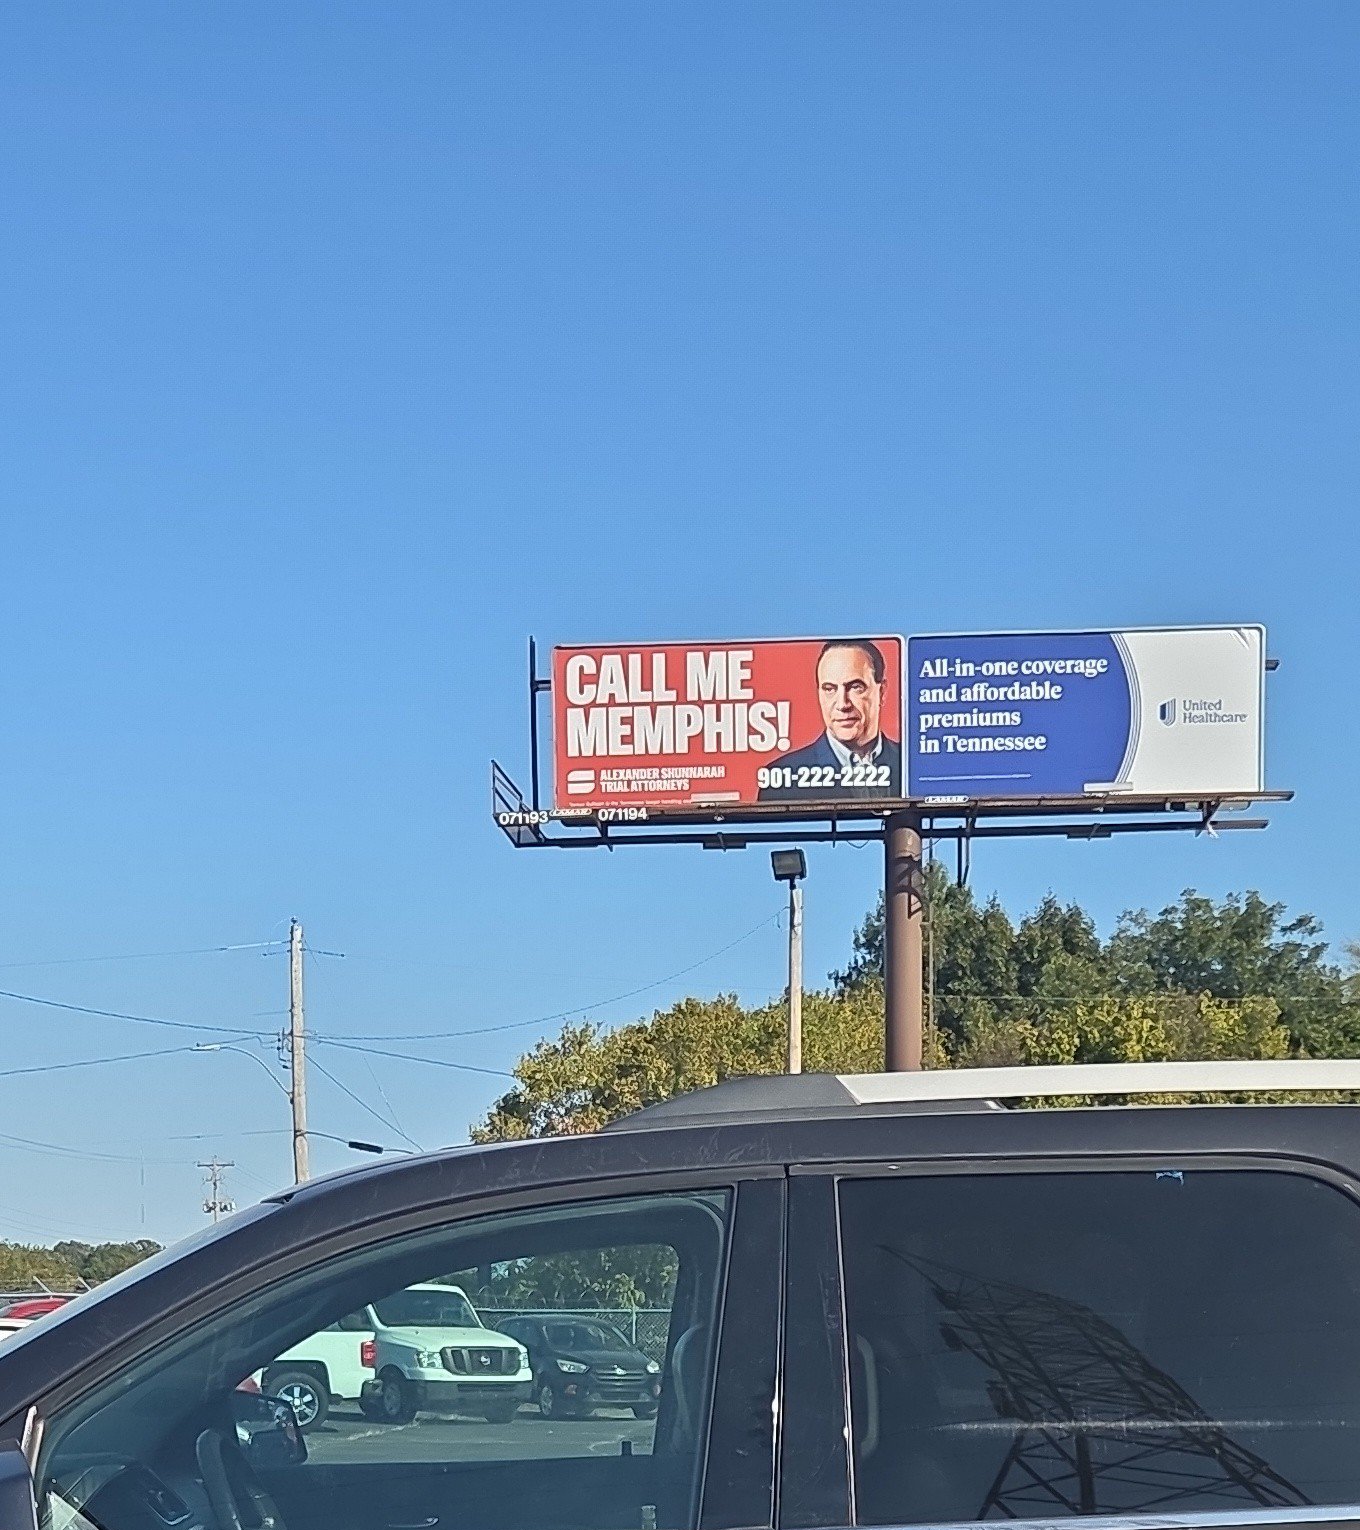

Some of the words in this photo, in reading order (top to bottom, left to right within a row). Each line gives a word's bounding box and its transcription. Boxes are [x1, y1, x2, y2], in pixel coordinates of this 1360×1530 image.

[566, 652, 677, 705] CALL
[686, 649, 754, 701] ME
[919, 658, 1018, 678] All-in-one
[1021, 658, 1108, 678] coverage
[919, 683, 957, 703] and
[960, 681, 1063, 702] affordable
[1182, 699, 1222, 711] United
[919, 708, 1021, 732] premiums
[1182, 712, 1248, 724] Healthcare
[566, 701, 790, 758] MEMPHIS!
[919, 735, 940, 753] in
[943, 735, 1047, 752] Tennessee
[599, 767, 660, 781] ALEXANDER
[661, 766, 725, 779] SHUNNARAH
[757, 765, 890, 789] 901-222-2222
[600, 781, 630, 793] TRIAL
[631, 779, 690, 792] ATTORNEYS
[498, 810, 549, 825] 071193
[597, 807, 648, 822] 071194
